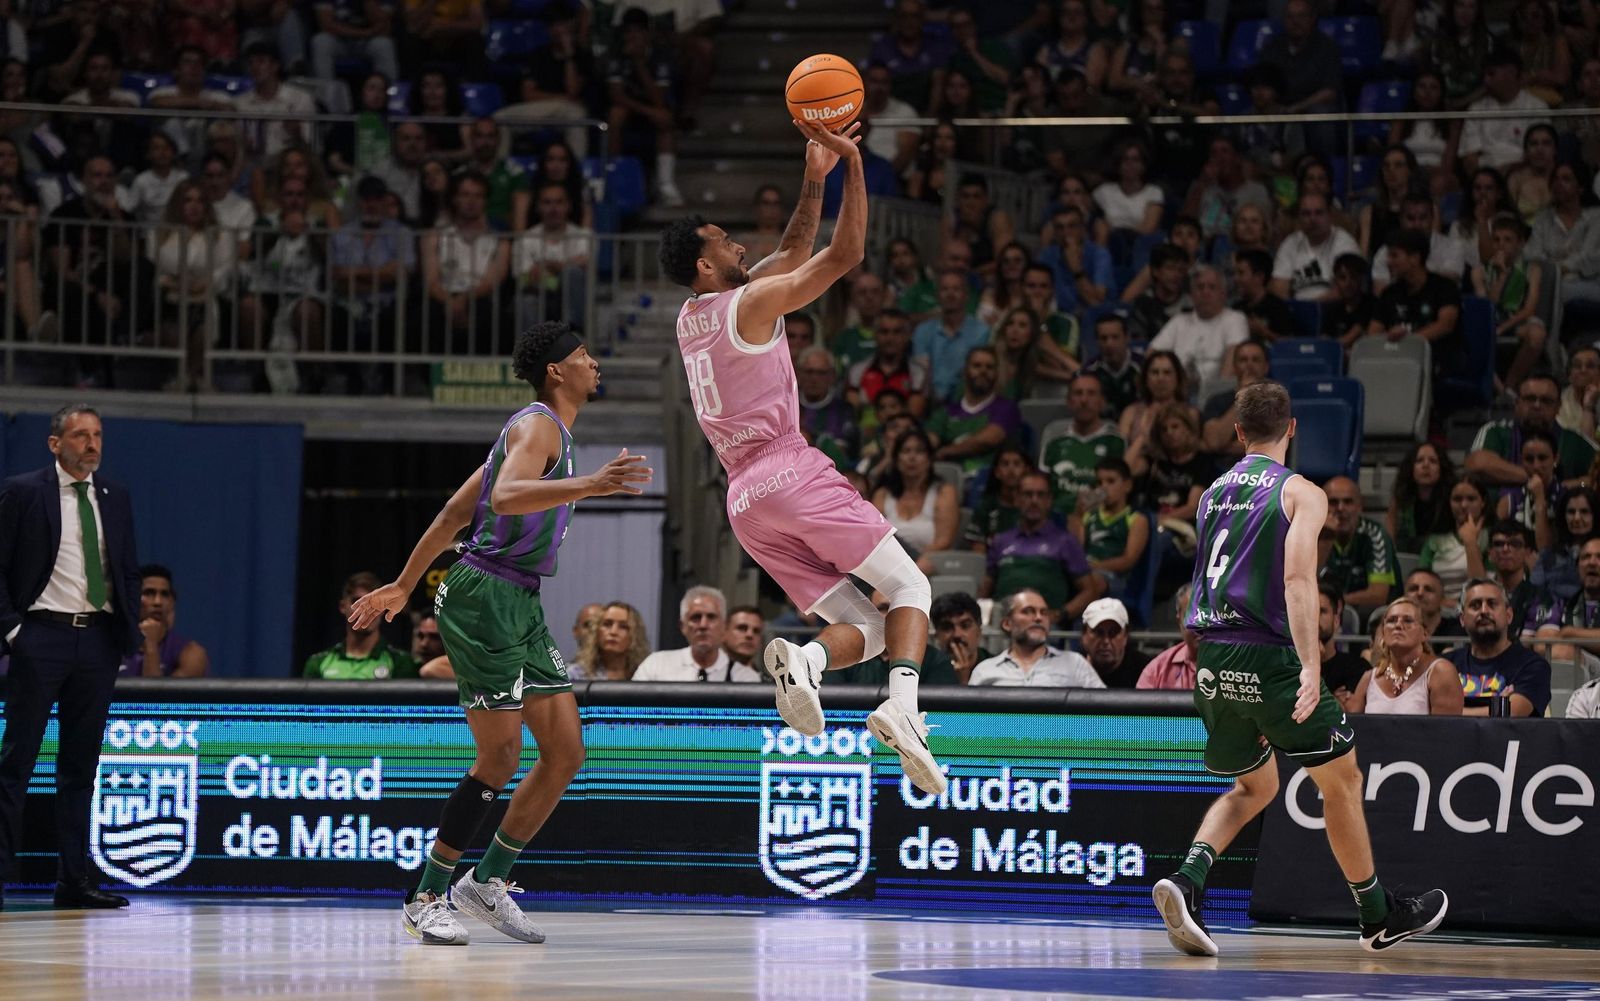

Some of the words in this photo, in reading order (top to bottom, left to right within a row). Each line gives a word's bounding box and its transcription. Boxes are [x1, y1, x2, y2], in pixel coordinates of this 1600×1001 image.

[802, 102, 854, 120] Wilson
[1206, 528, 1229, 589] 4
[1219, 669, 1261, 684] COSTA
[1219, 682, 1238, 693] DEL
[1240, 684, 1262, 695] SOL
[1222, 691, 1263, 703] MÁLAGA
[224, 754, 382, 800] Ciudad
[900, 764, 1072, 813] Ciudad
[222, 812, 280, 858] de
[899, 826, 959, 871] de
[972, 828, 1145, 886] Málaga
